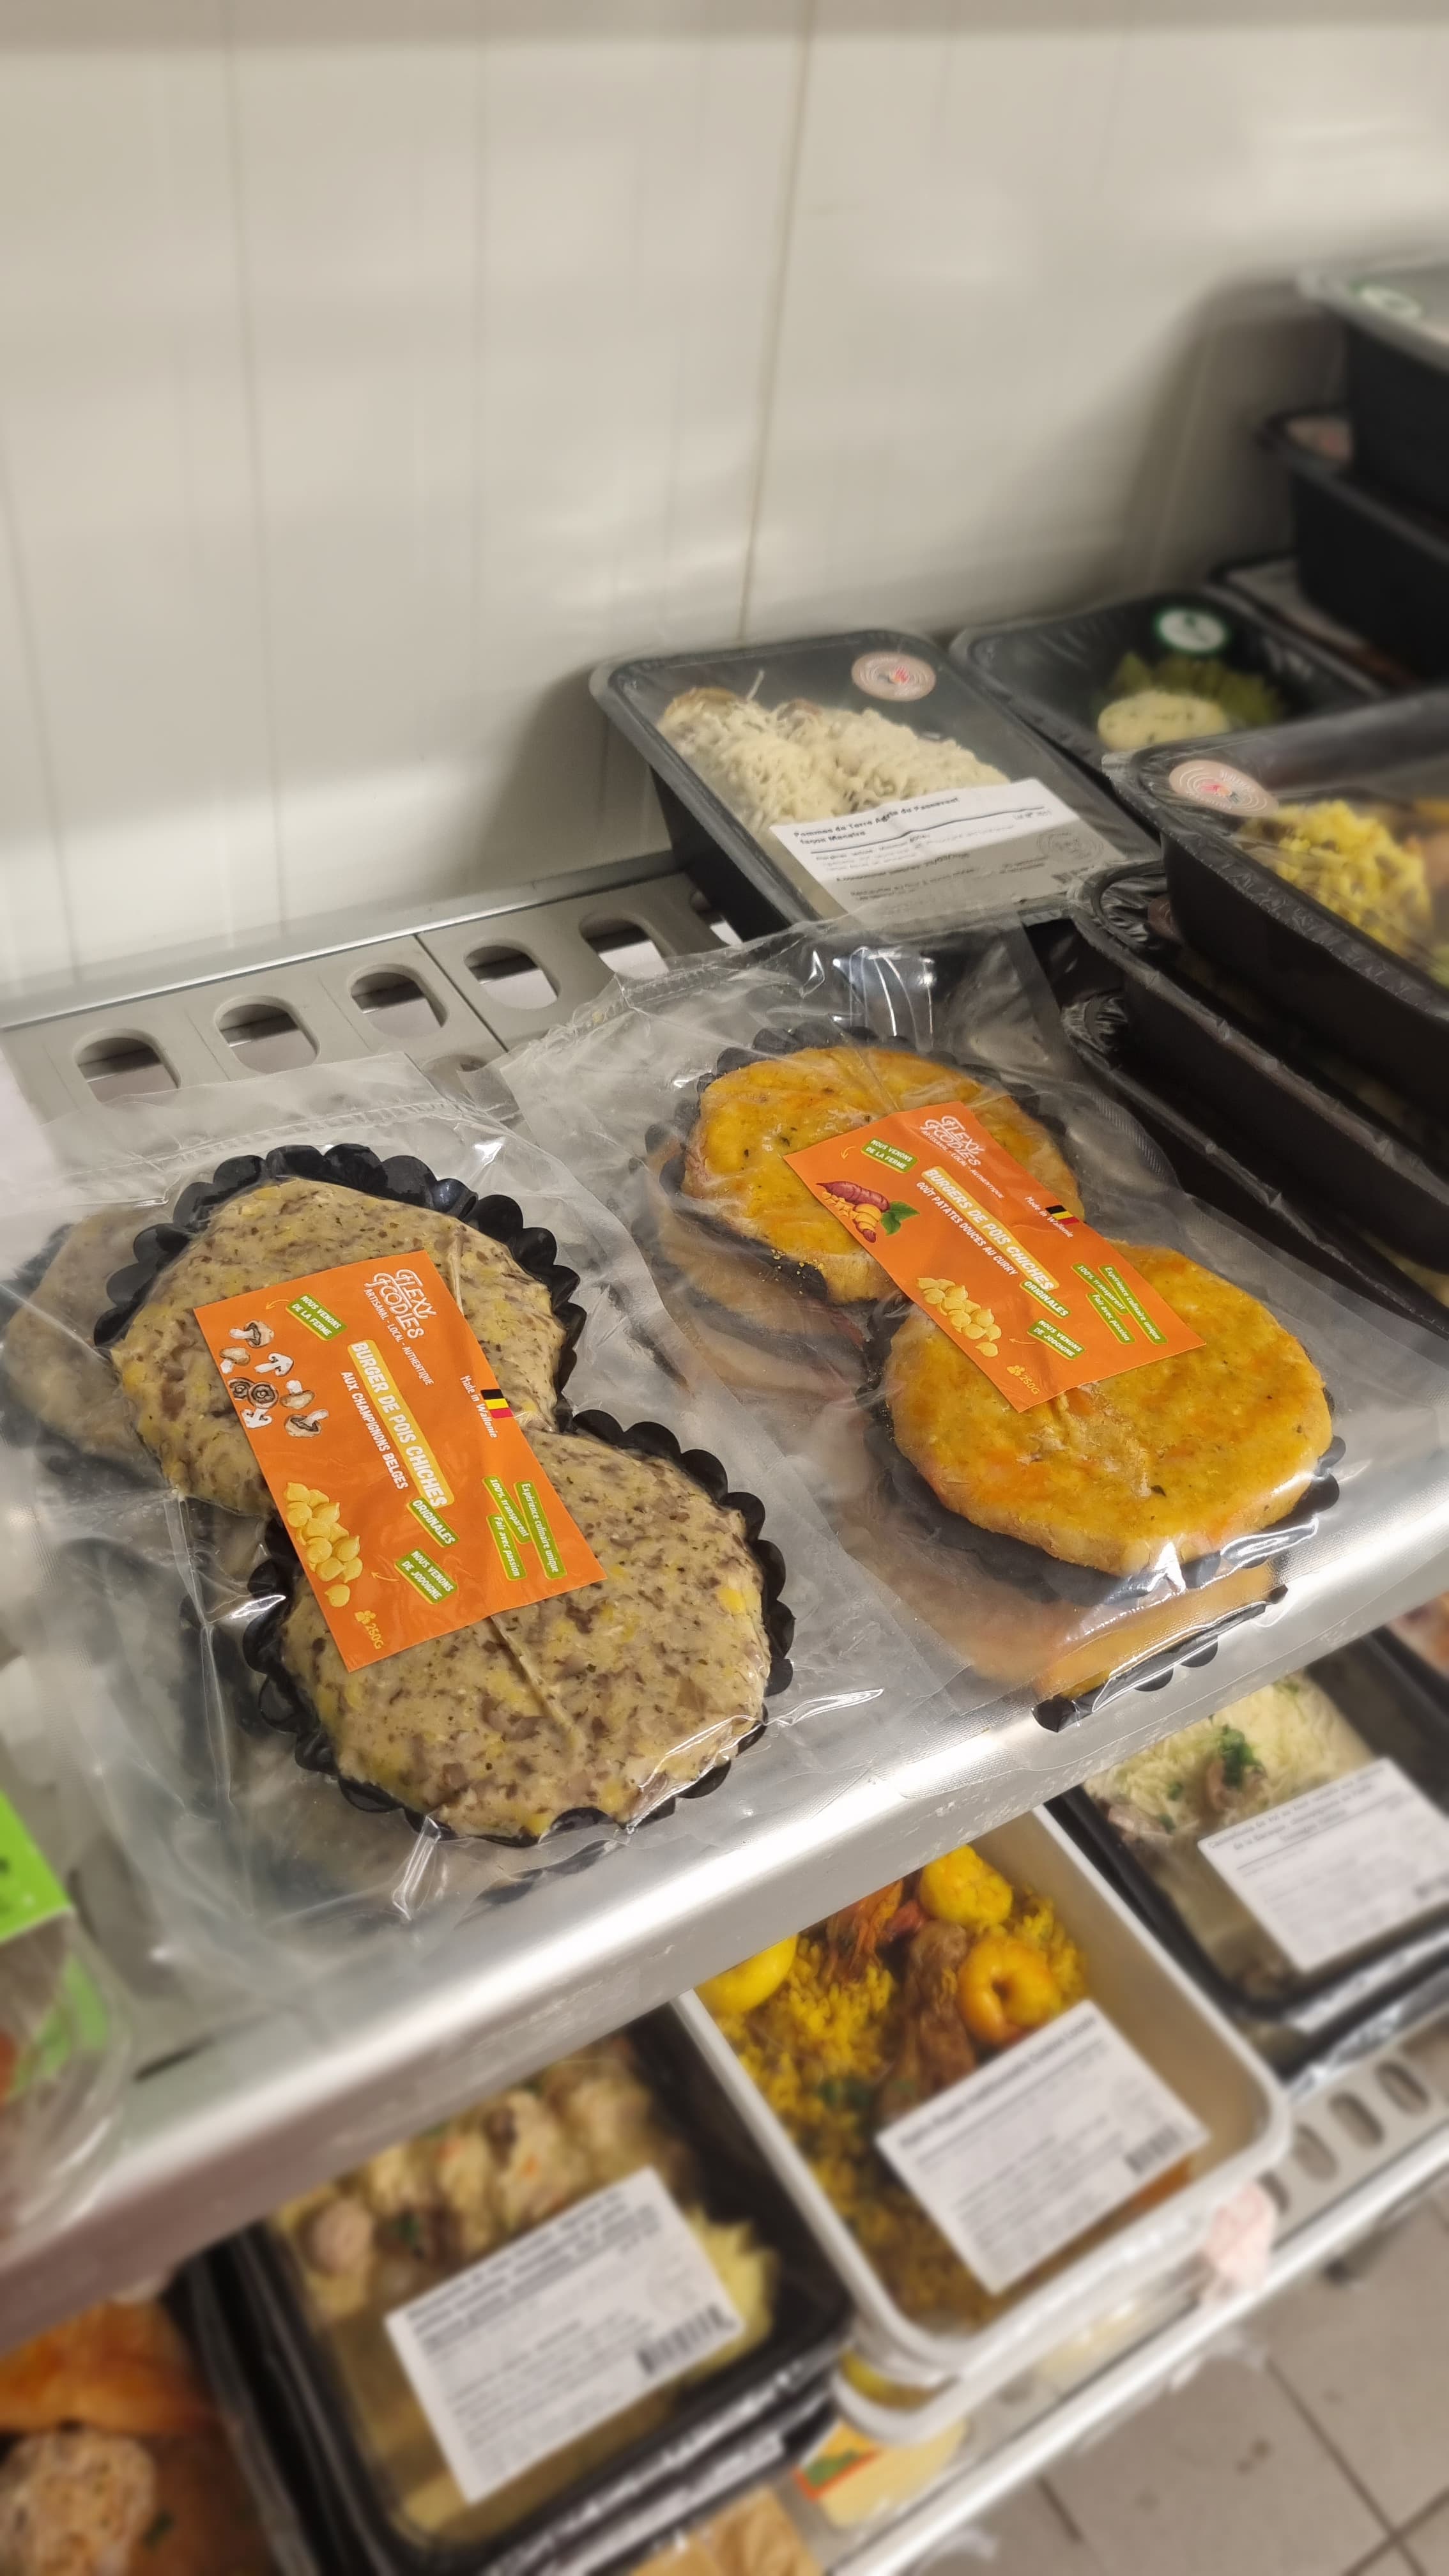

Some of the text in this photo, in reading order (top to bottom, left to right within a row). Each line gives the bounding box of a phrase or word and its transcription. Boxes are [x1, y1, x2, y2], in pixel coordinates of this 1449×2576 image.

[865, 1146, 907, 1170] DE LA FERME
[870, 1138, 914, 1163] NOUS VENONS
[1025, 1196, 1041, 1211] Made
[916, 1182, 1018, 1276] GOÛT PATATES DOUCES AU CURRY
[925, 1169, 1055, 1291] BURGERS DE POIS CHICHES
[395, 1269, 437, 1319] FLEXY
[1023, 1281, 1070, 1317] ORIGINALES
[1077, 1265, 1126, 1310] 100% transparent
[1105, 1267, 1161, 1340] Expérience culinaire unique
[291, 1303, 333, 1337] DE LA FERME
[300, 1294, 342, 1330] NOUS VENONS
[1092, 1294, 1130, 1342] Fait avec passion
[364, 1289, 386, 1321] ARTISANAL
[387, 1324, 404, 1342] LOCAL
[402, 1346, 434, 1386] AUTHENTIQUE
[1033, 1327, 1076, 1357] DE JODOIGNE
[1038, 1319, 1083, 1353] NOUS VENONS
[351, 1341, 448, 1508] BURGER DE POIS CHICHES
[460, 1375, 498, 1439] Made in Wallonie
[341, 1372, 409, 1490] AUX CHAMPIGNONS BELGES
[411, 1499, 456, 1545] ORIGINALES
[489, 1478, 530, 1538] 100% transparent
[520, 1483, 560, 1574] Expérience culinaire unique
[493, 1516, 521, 1577] Fait avec passion
[401, 1560, 443, 1600] DE JODOIGNE
[410, 1551, 454, 1593] NOUS VENONS
[365, 1623, 384, 1650] 250G
